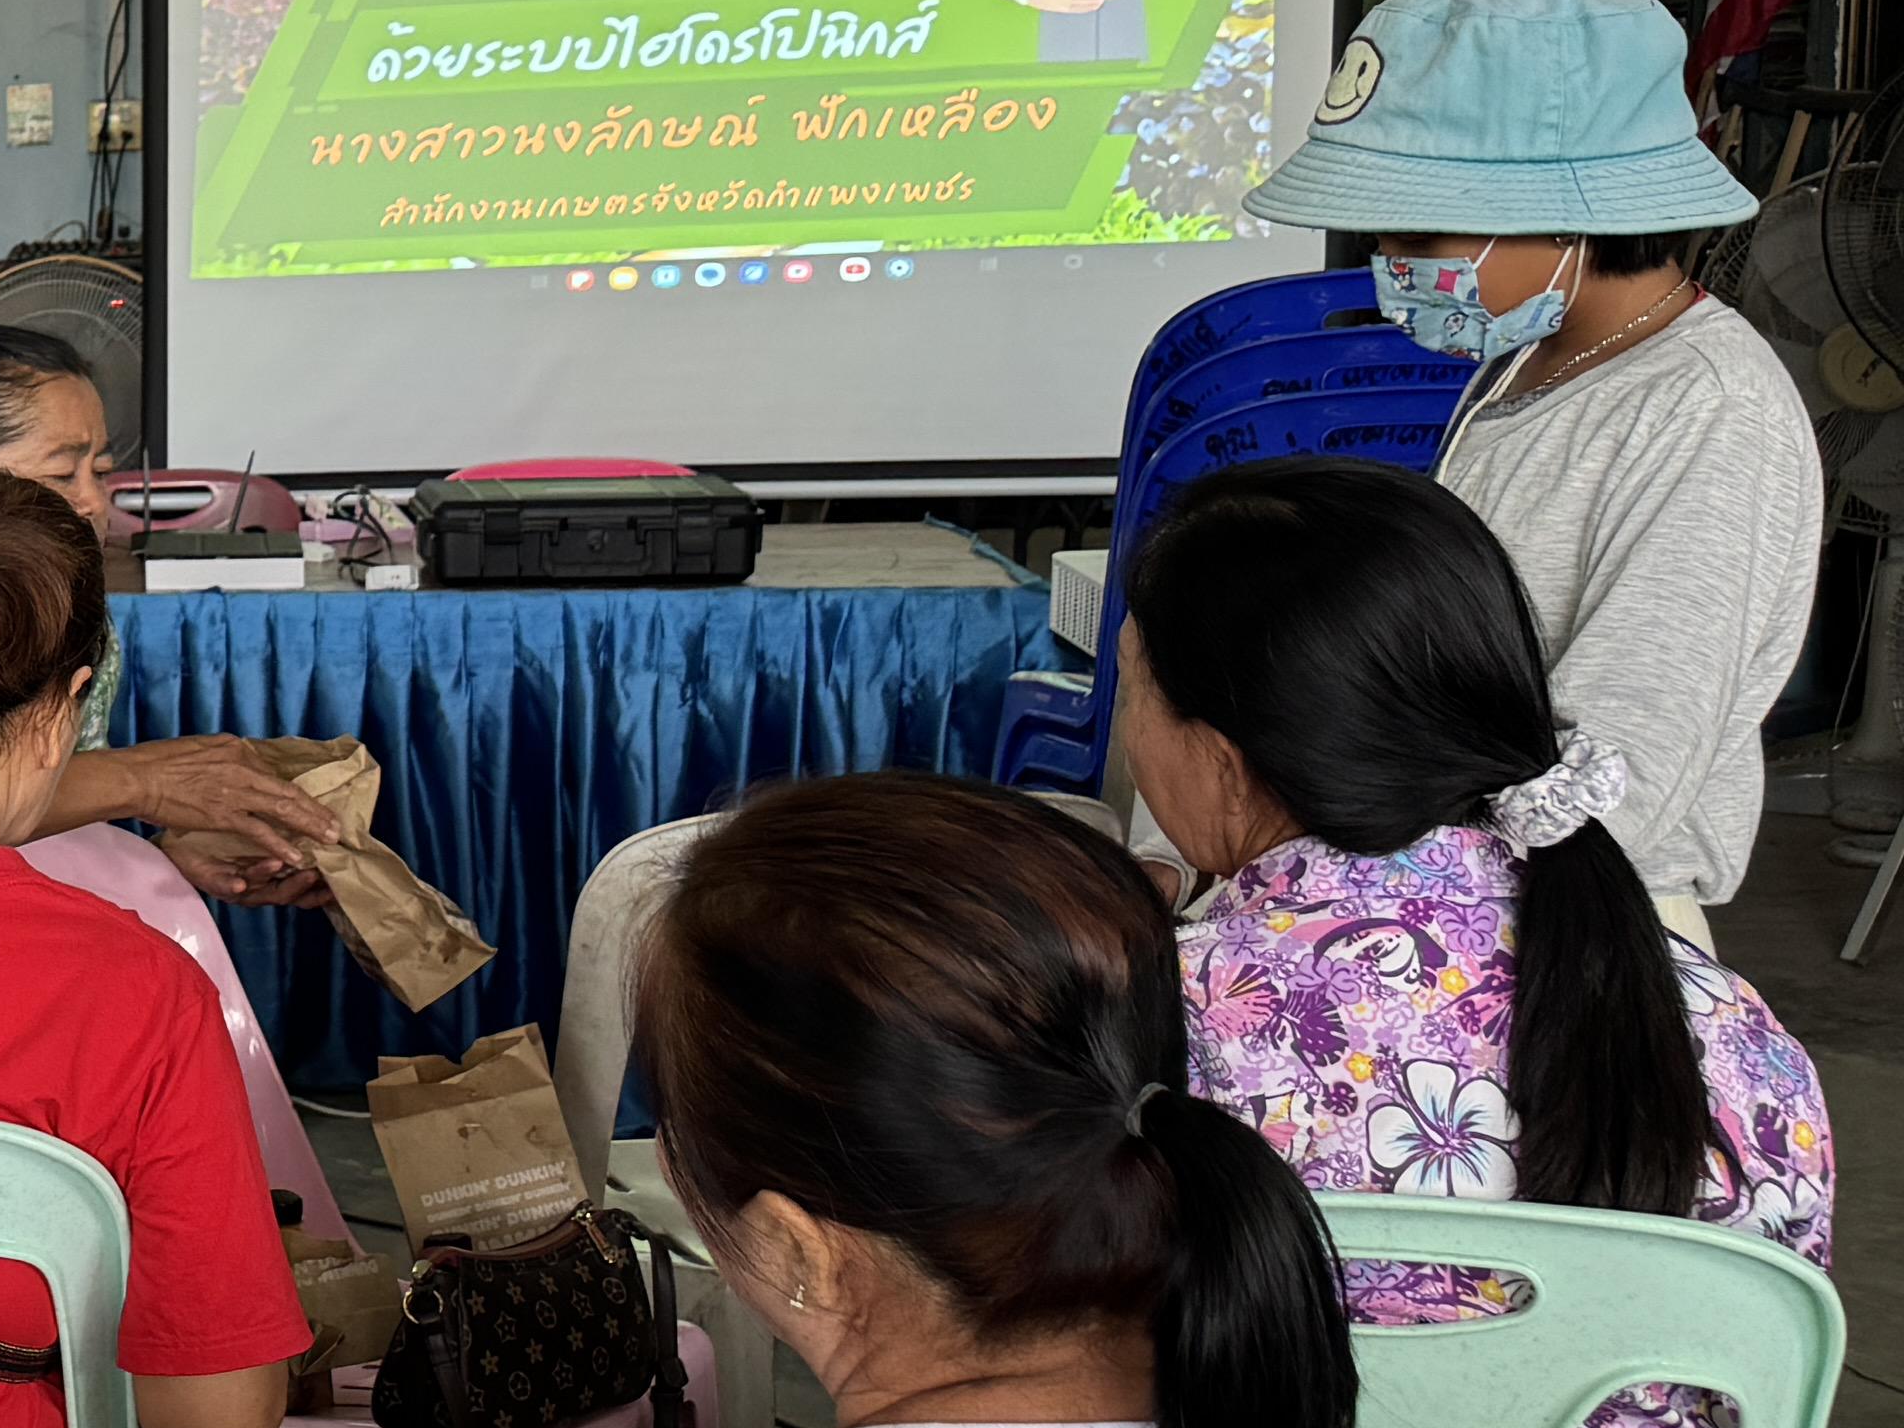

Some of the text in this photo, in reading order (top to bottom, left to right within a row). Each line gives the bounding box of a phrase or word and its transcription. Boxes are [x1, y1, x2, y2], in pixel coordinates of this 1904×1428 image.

[311, 88, 1058, 167] นางสาวนงลักษณ์ ฟักเหลือง
[380, 172, 976, 228] สำนักงานเกษตรจังหวัดกำแพงเพชร
